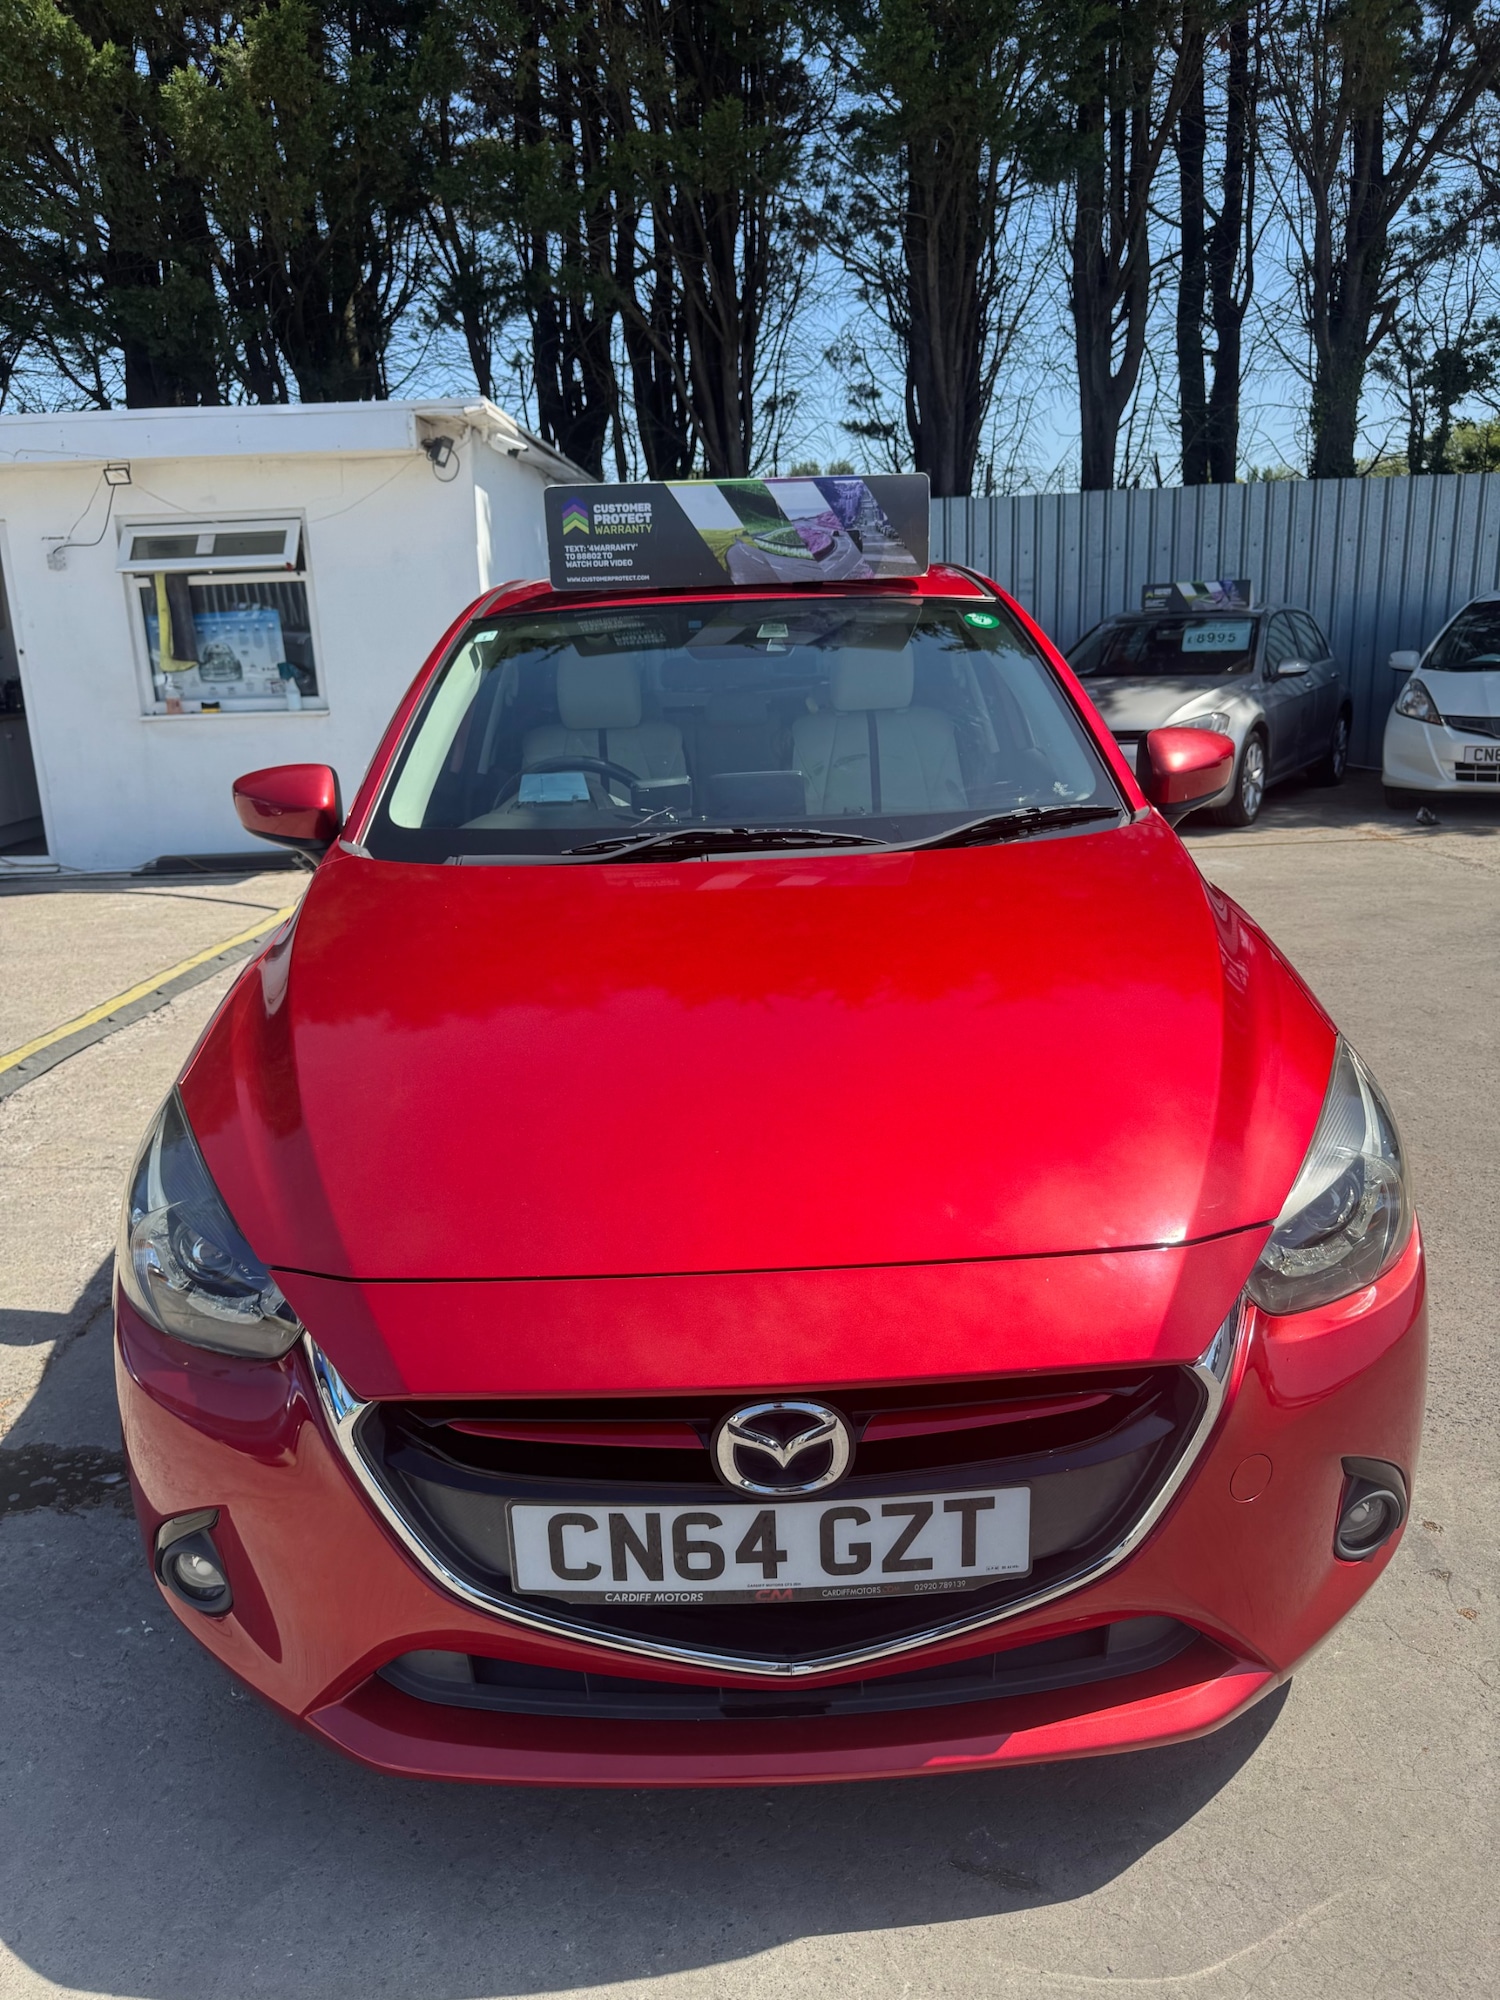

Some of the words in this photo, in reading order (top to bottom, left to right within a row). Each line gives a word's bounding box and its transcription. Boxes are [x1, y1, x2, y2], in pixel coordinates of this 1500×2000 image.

[593, 502, 652, 514] CUSTOMER
[593, 513, 652, 525] PROTECT
[594, 524, 652, 535] WARRANTY
[564, 545, 587, 553] TEXT:
[565, 553, 576, 561] TO
[602, 552, 613, 560] TO
[565, 560, 592, 569] WATCH
[593, 559, 609, 568] OUR
[610, 559, 633, 567] VIDEO
[547, 1509, 788, 1582] CN64
[818, 1496, 996, 1577] GZT
[914, 1582, 937, 1591] 02920
[938, 1580, 966, 1590] 789139
[604, 1592, 652, 1603] CARDIFF
[654, 1592, 704, 1602] MOTORS
[754, 1588, 794, 1601] CM
